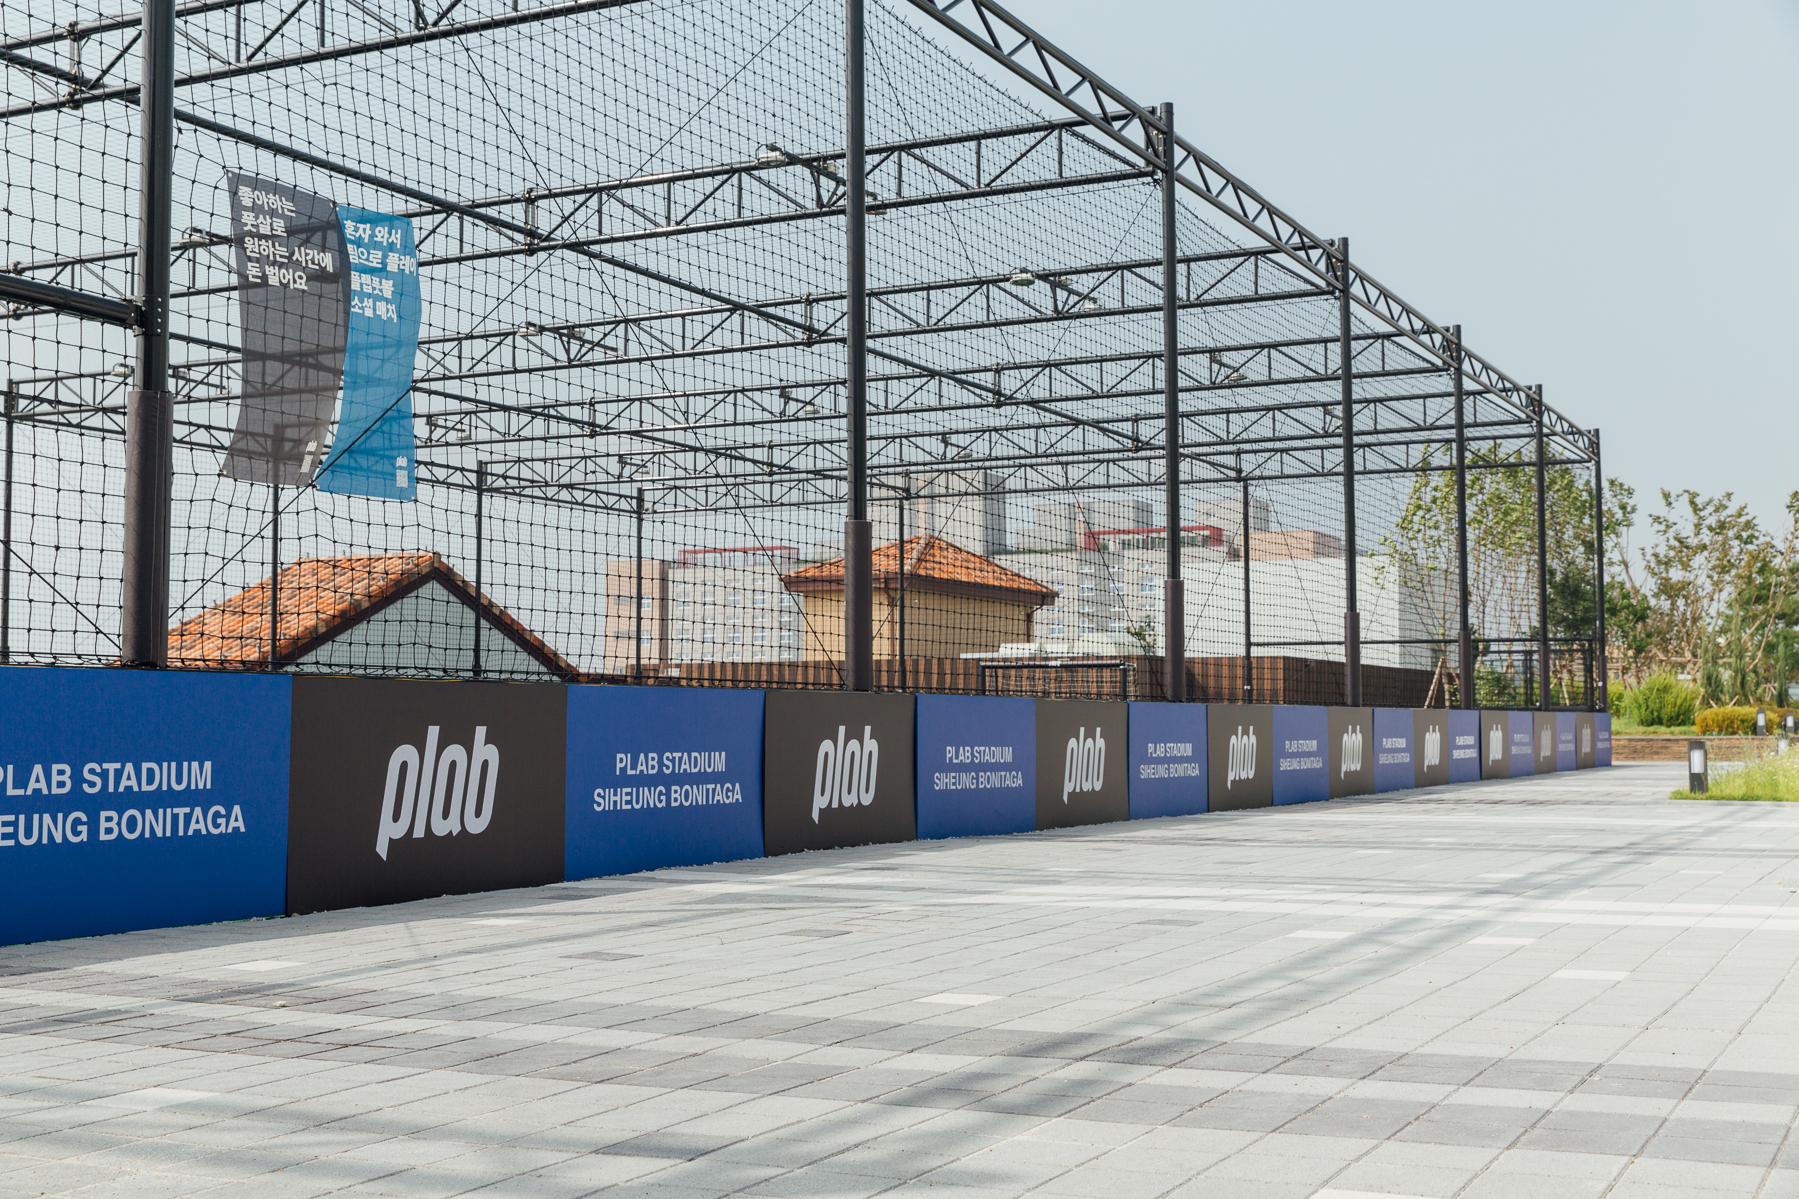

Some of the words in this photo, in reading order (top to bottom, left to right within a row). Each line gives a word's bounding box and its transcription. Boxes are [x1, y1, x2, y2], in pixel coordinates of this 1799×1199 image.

[238, 185, 296, 217] 좋아하는
[241, 210, 288, 237] 풋살로
[344, 219, 372, 243] 혼자
[374, 226, 401, 249] 와서
[244, 236, 289, 263] 원하는
[292, 246, 334, 273] 시간에
[386, 252, 417, 277] 플레이
[246, 261, 262, 283] 돈
[265, 264, 308, 290] 벌어요
[350, 295, 374, 318] 소셜
[375, 300, 398, 323] 매치
[615, 752, 659, 776] PLAB
[662, 751, 726, 775] STADIUM
[946, 746, 972, 764] PLAB
[973, 746, 1013, 764] STADIUM
[1147, 743, 1165, 757] PLAB
[1166, 742, 1193, 757] STADIUM
[1227, 725, 1257, 790] plab
[1341, 725, 1363, 780] plab
[0, 763, 72, 796] LAB
[82, 760, 212, 794] STADIUM
[811, 725, 879, 825] plab
[933, 771, 977, 791] SIHEUNG
[978, 770, 1023, 789] BONITAGA
[1063, 726, 1106, 805] plab
[376, 725, 500, 862] plab
[593, 785, 666, 812] SIHEUNG
[670, 782, 743, 807] BONITAGA
[99, 804, 245, 841] BONITAGA
